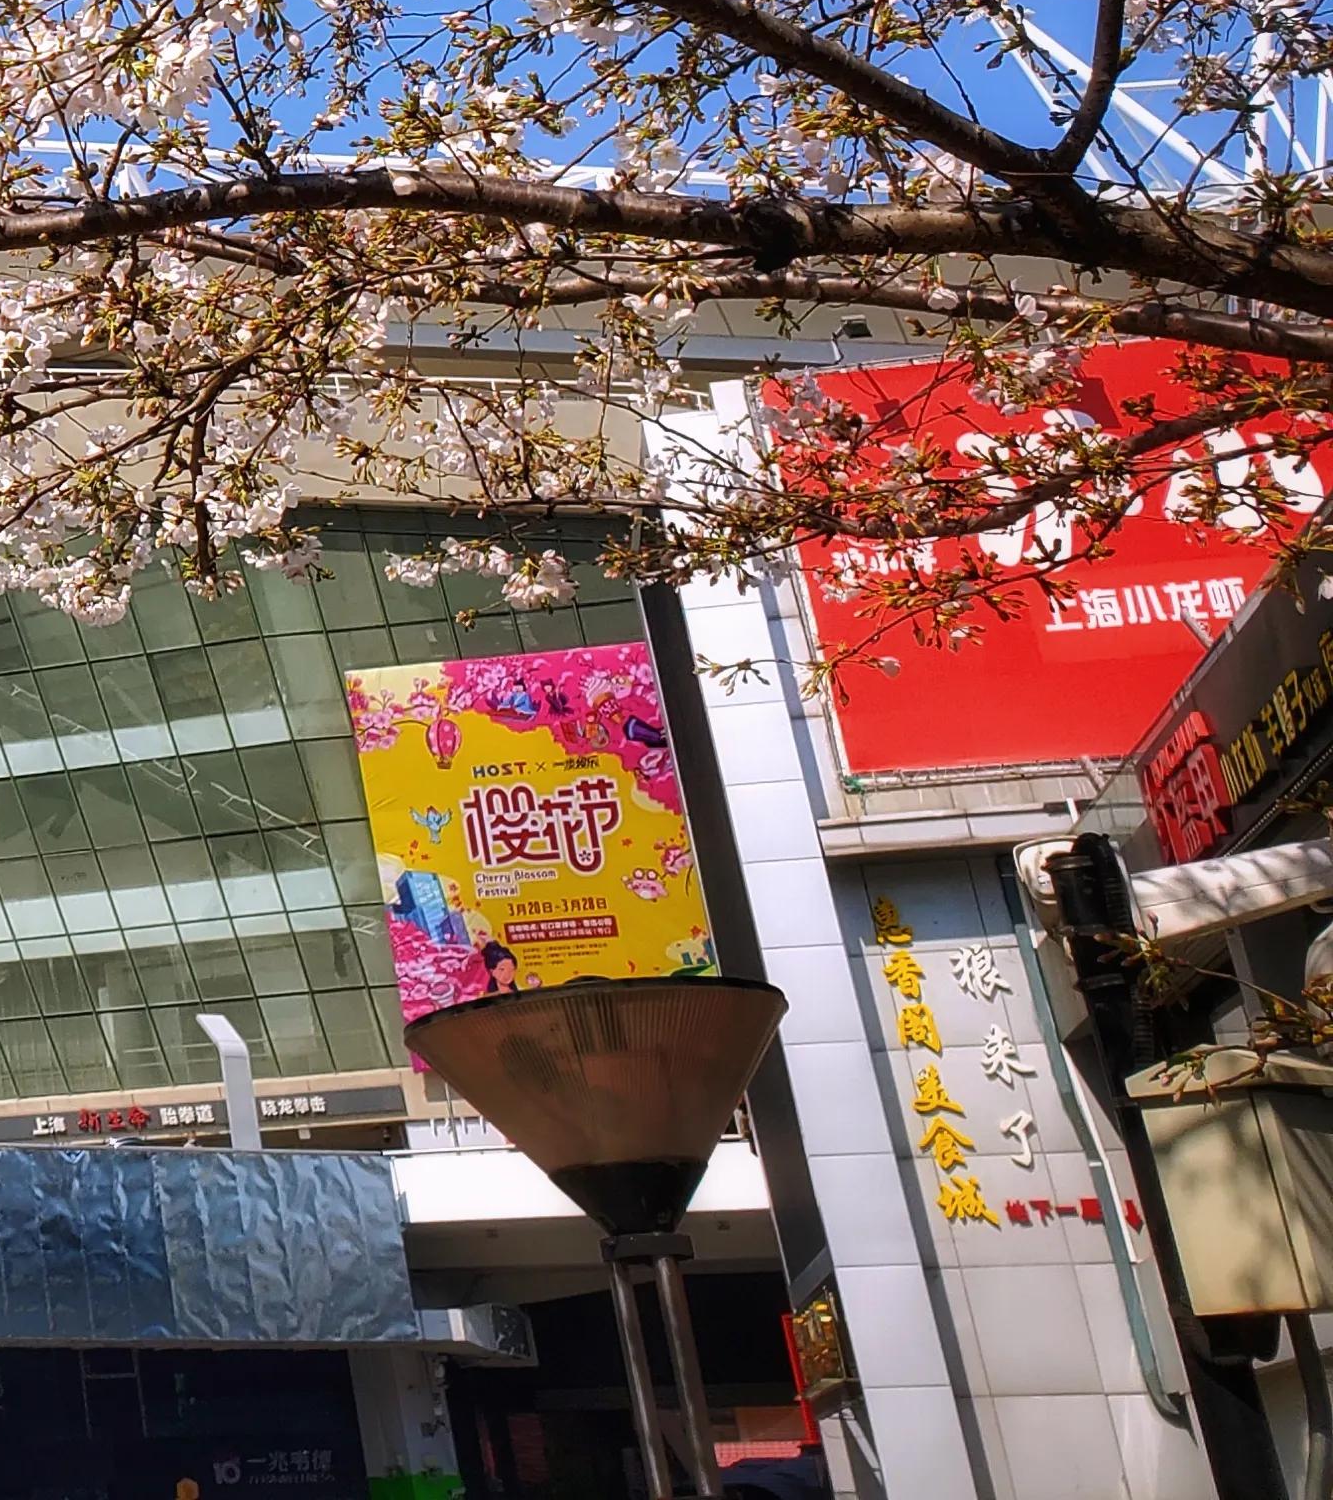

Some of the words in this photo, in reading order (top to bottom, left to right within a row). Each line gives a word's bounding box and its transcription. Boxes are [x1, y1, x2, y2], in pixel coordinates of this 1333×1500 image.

[1044, 577, 1245, 632] 上海小龙虾
[463, 778, 620, 873] 樱花节
[475, 873, 511, 885] Cherry
[514, 869, 556, 880] Blossom
[477, 886, 518, 898] Festival
[950, 945, 1036, 1167] 狼来了
[33, 1116, 67, 1136] 上海
[78, 1105, 151, 1132] 新生命
